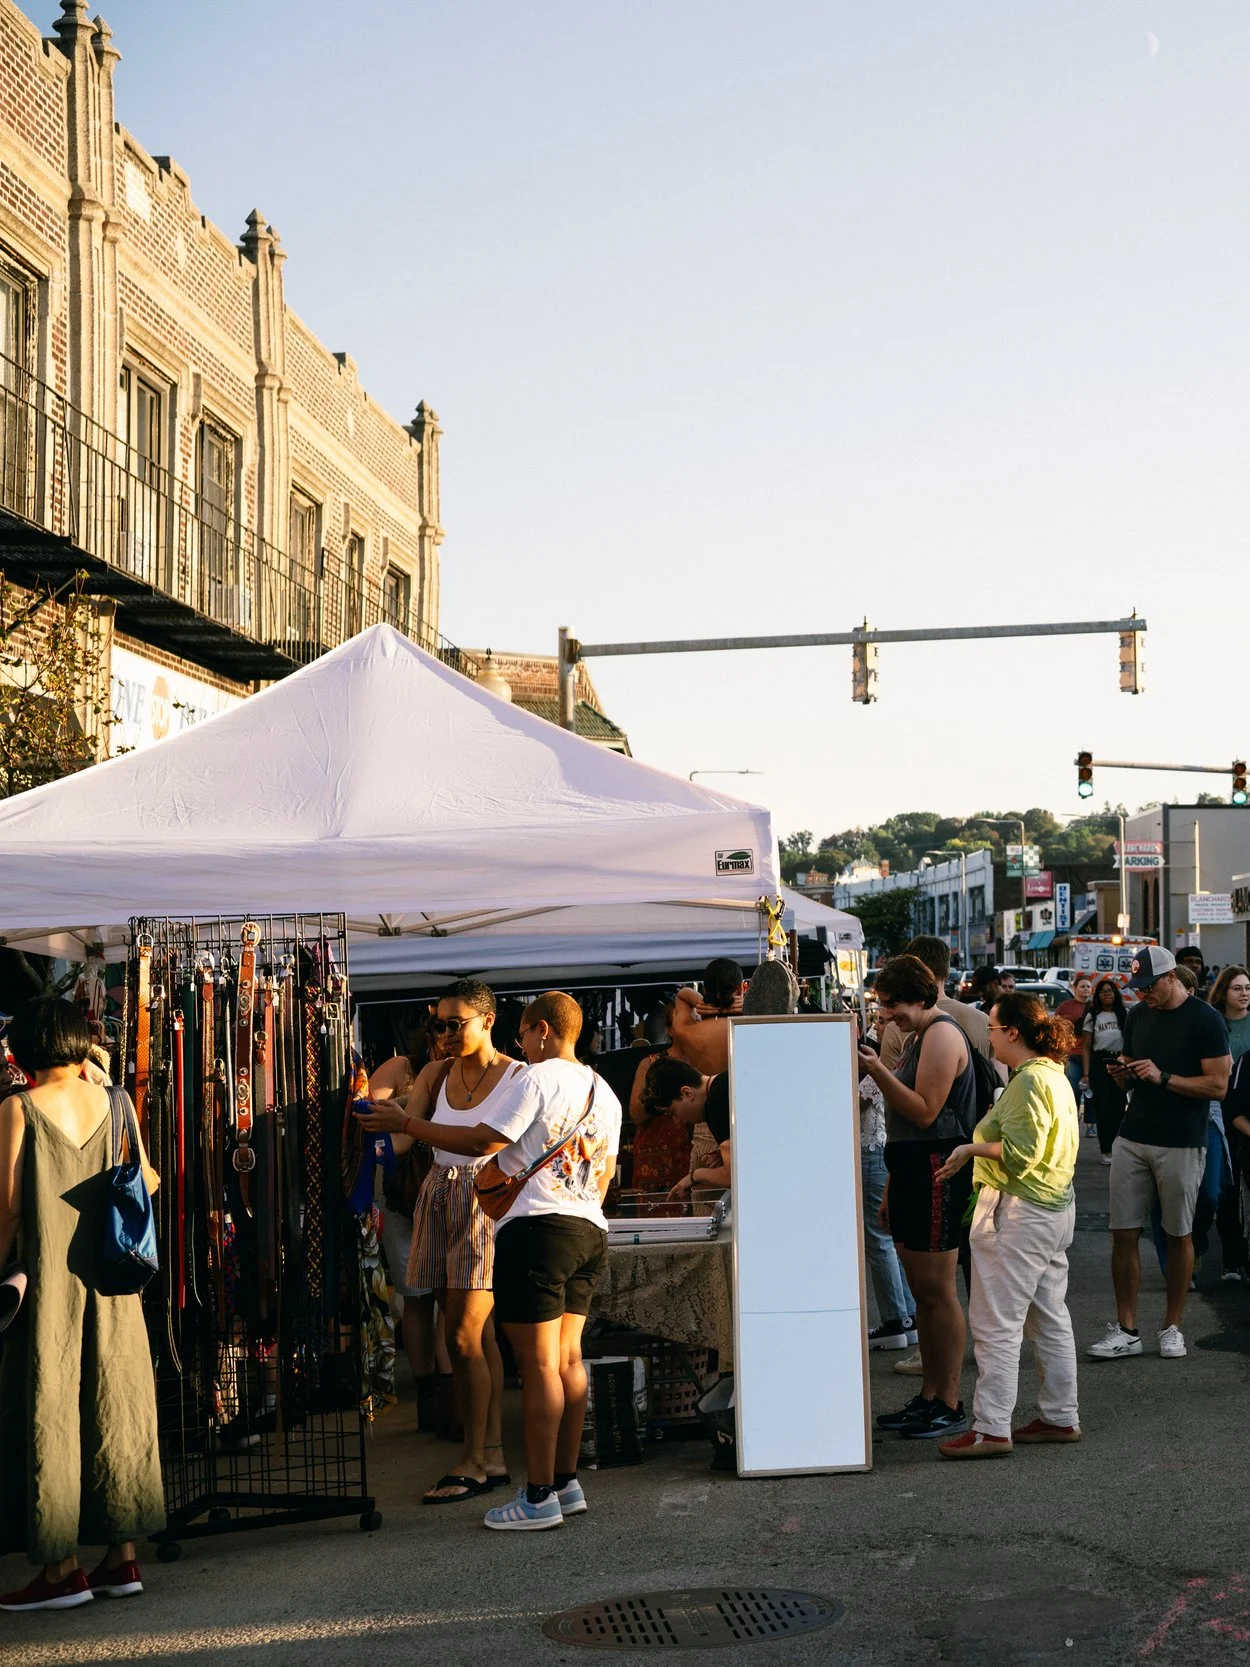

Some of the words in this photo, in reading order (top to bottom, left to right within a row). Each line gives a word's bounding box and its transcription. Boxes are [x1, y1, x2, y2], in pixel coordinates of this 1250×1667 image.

[717, 860, 750, 870] Eurmax
[1124, 856, 1159, 866] ARKING
[1059, 885, 1067, 926] DENTIST
[1098, 1021, 1119, 1030] NANTUC
